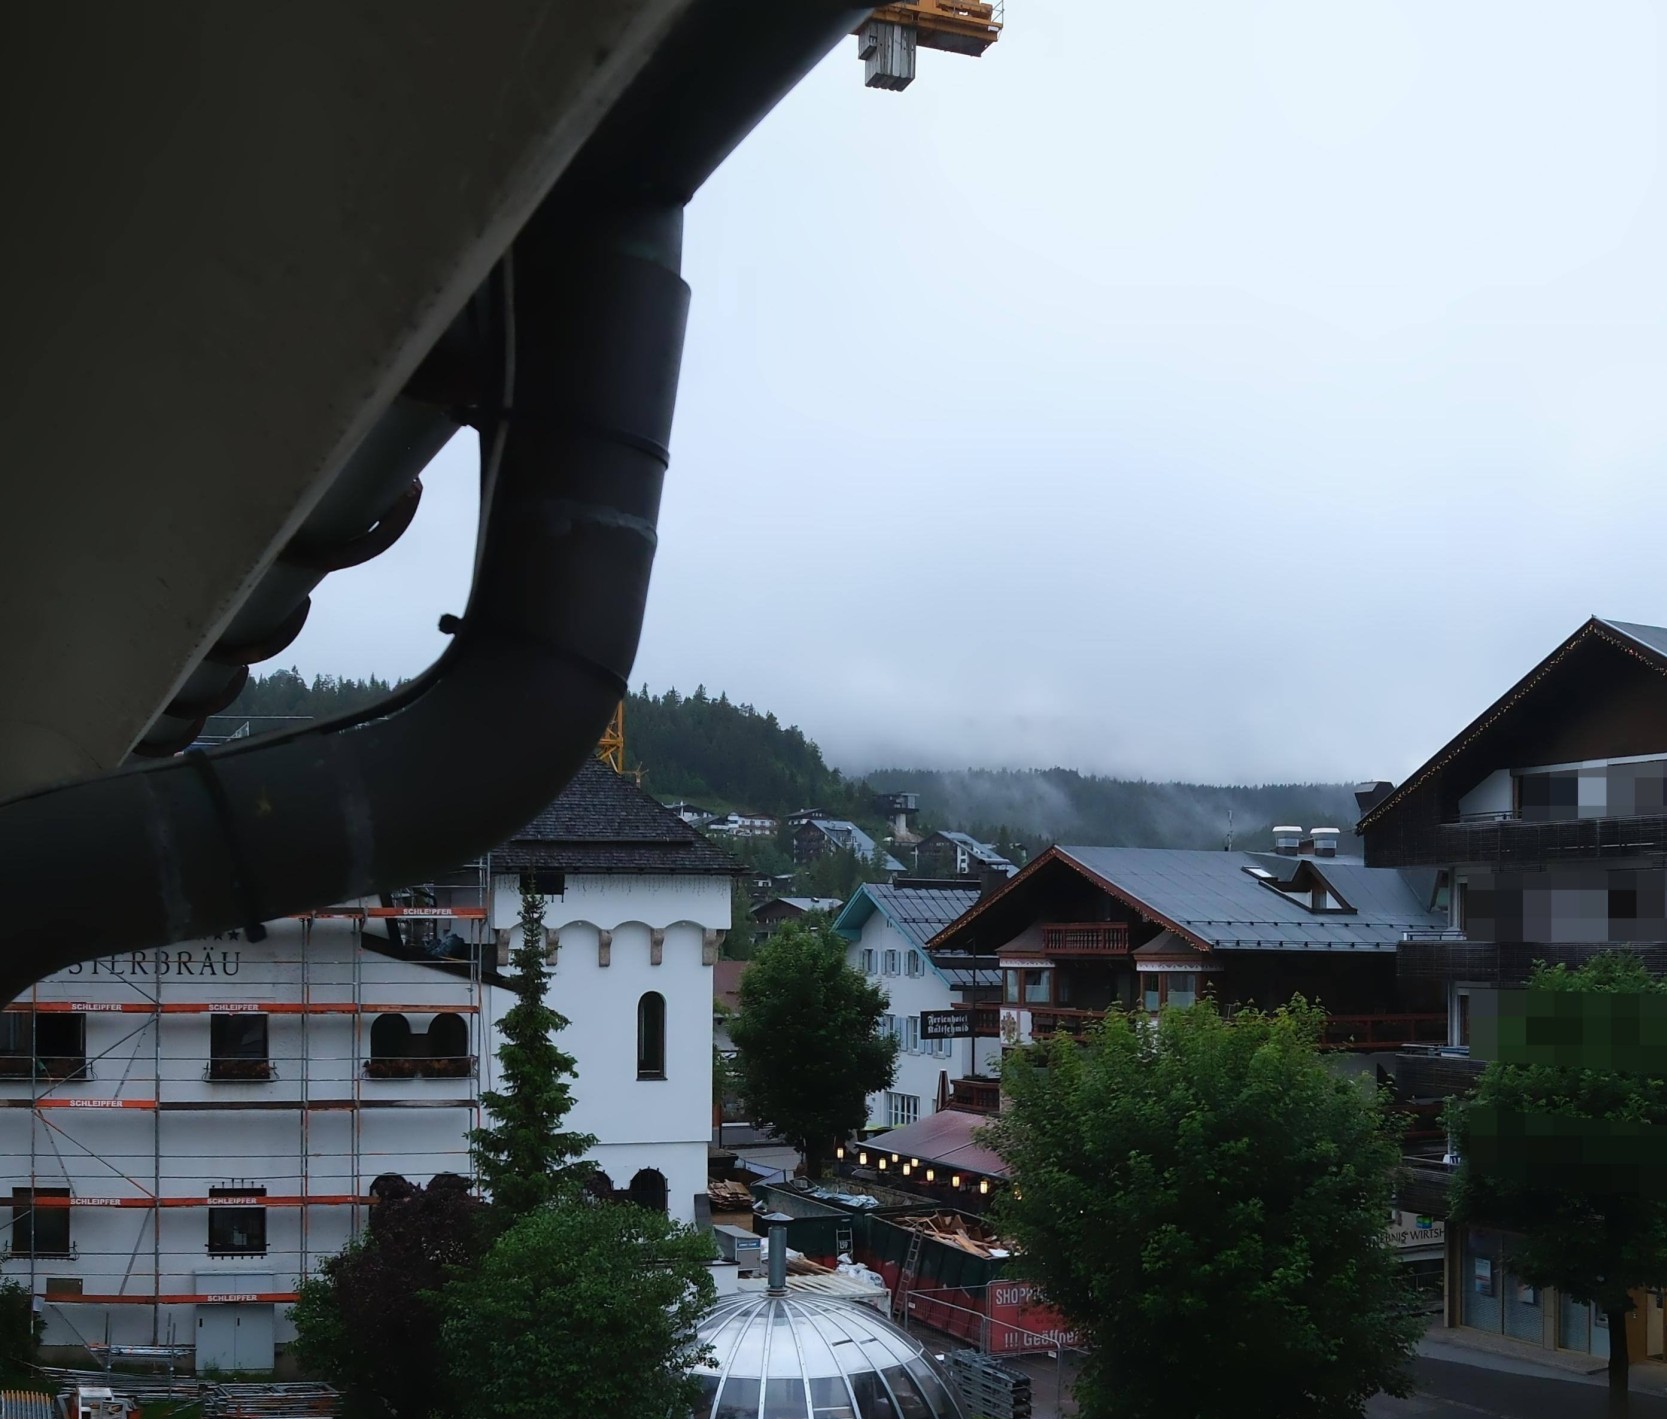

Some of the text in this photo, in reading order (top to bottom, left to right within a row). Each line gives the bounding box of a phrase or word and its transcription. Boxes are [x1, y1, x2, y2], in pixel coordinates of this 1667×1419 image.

[71, 1003, 122, 1011] SCHLEIPFER
[208, 1003, 259, 1011] SCHLEIPFER
[69, 1099, 123, 1107] SCHLEIPFER
[70, 1198, 121, 1206] SCHLEIPFER
[207, 1197, 257, 1205] SCHLEIPFER
[207, 1294, 257, 1302] SCHLEIPFER
